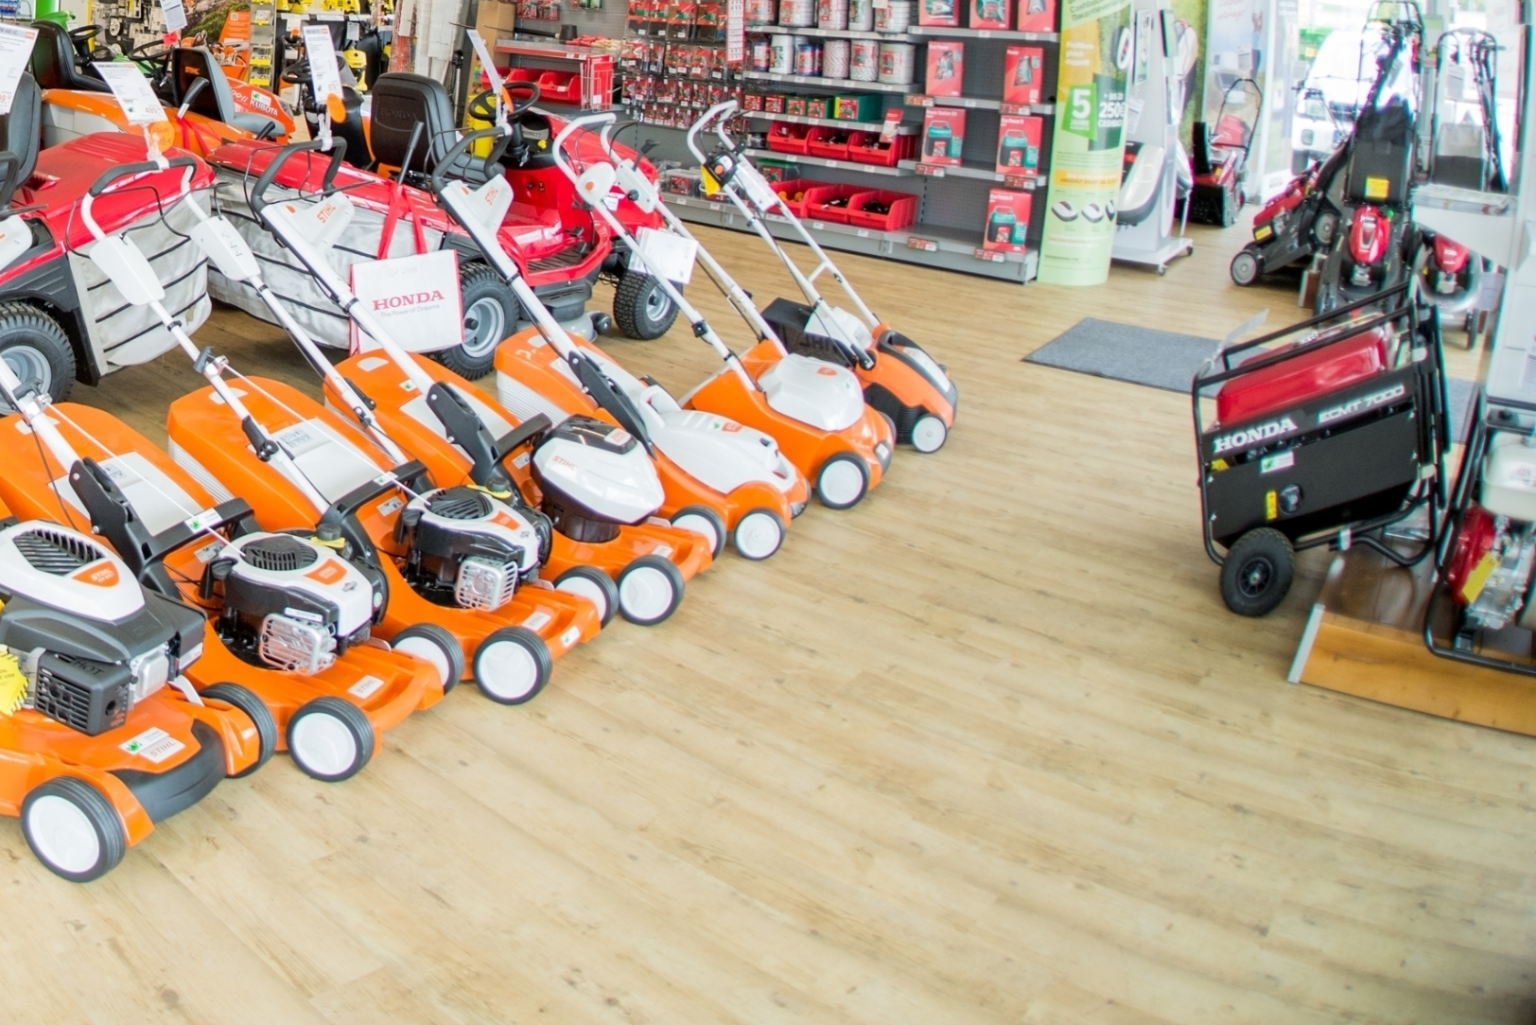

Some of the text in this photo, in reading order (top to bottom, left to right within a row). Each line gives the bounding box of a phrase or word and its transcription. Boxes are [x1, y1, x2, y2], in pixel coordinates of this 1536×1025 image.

[250, 98, 278, 117] KUBOTA
[1071, 88, 1091, 119] 5
[484, 186, 499, 206] STIHL
[316, 202, 337, 224] STIHL
[372, 290, 445, 311] HONDA
[417, 304, 440, 313] Dreams
[1365, 383, 1405, 409] 7000
[1214, 418, 1298, 453] HONDA
[552, 455, 577, 471] STIHL
[76, 658, 105, 676] HOT
[357, 679, 377, 694] STIHL
[150, 741, 176, 757] STIHL
